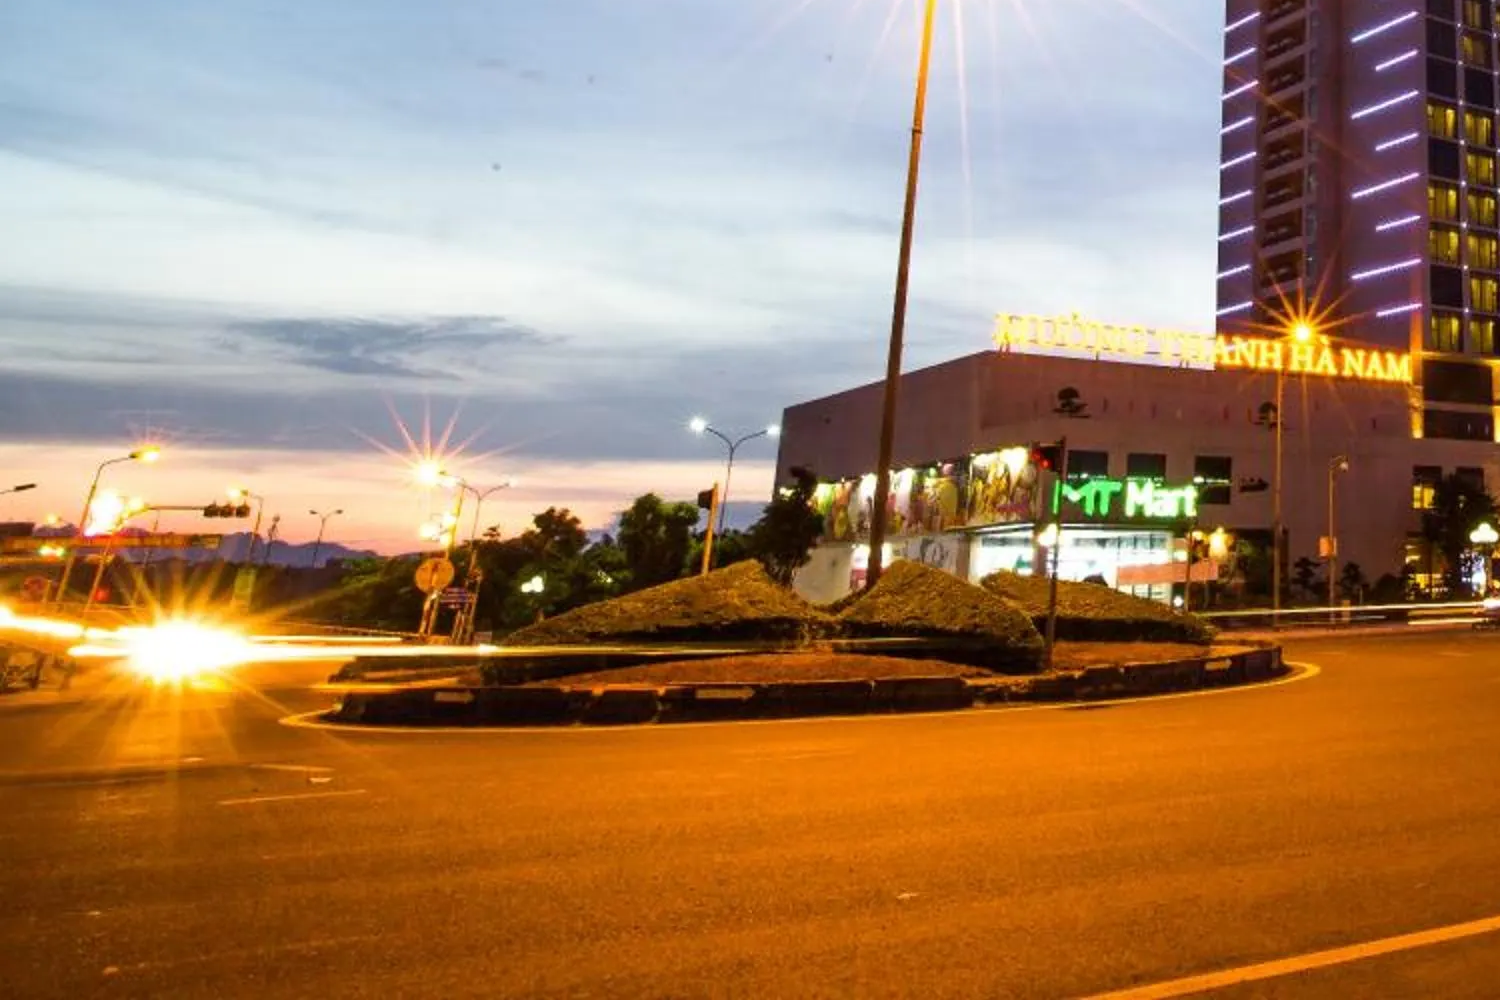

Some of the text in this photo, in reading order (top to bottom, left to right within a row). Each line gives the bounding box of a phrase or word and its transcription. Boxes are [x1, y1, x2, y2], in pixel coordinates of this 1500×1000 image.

[1289, 336, 1337, 376] HÀ
[1341, 347, 1413, 383] NAM
[1125, 476, 1197, 518] Mart
